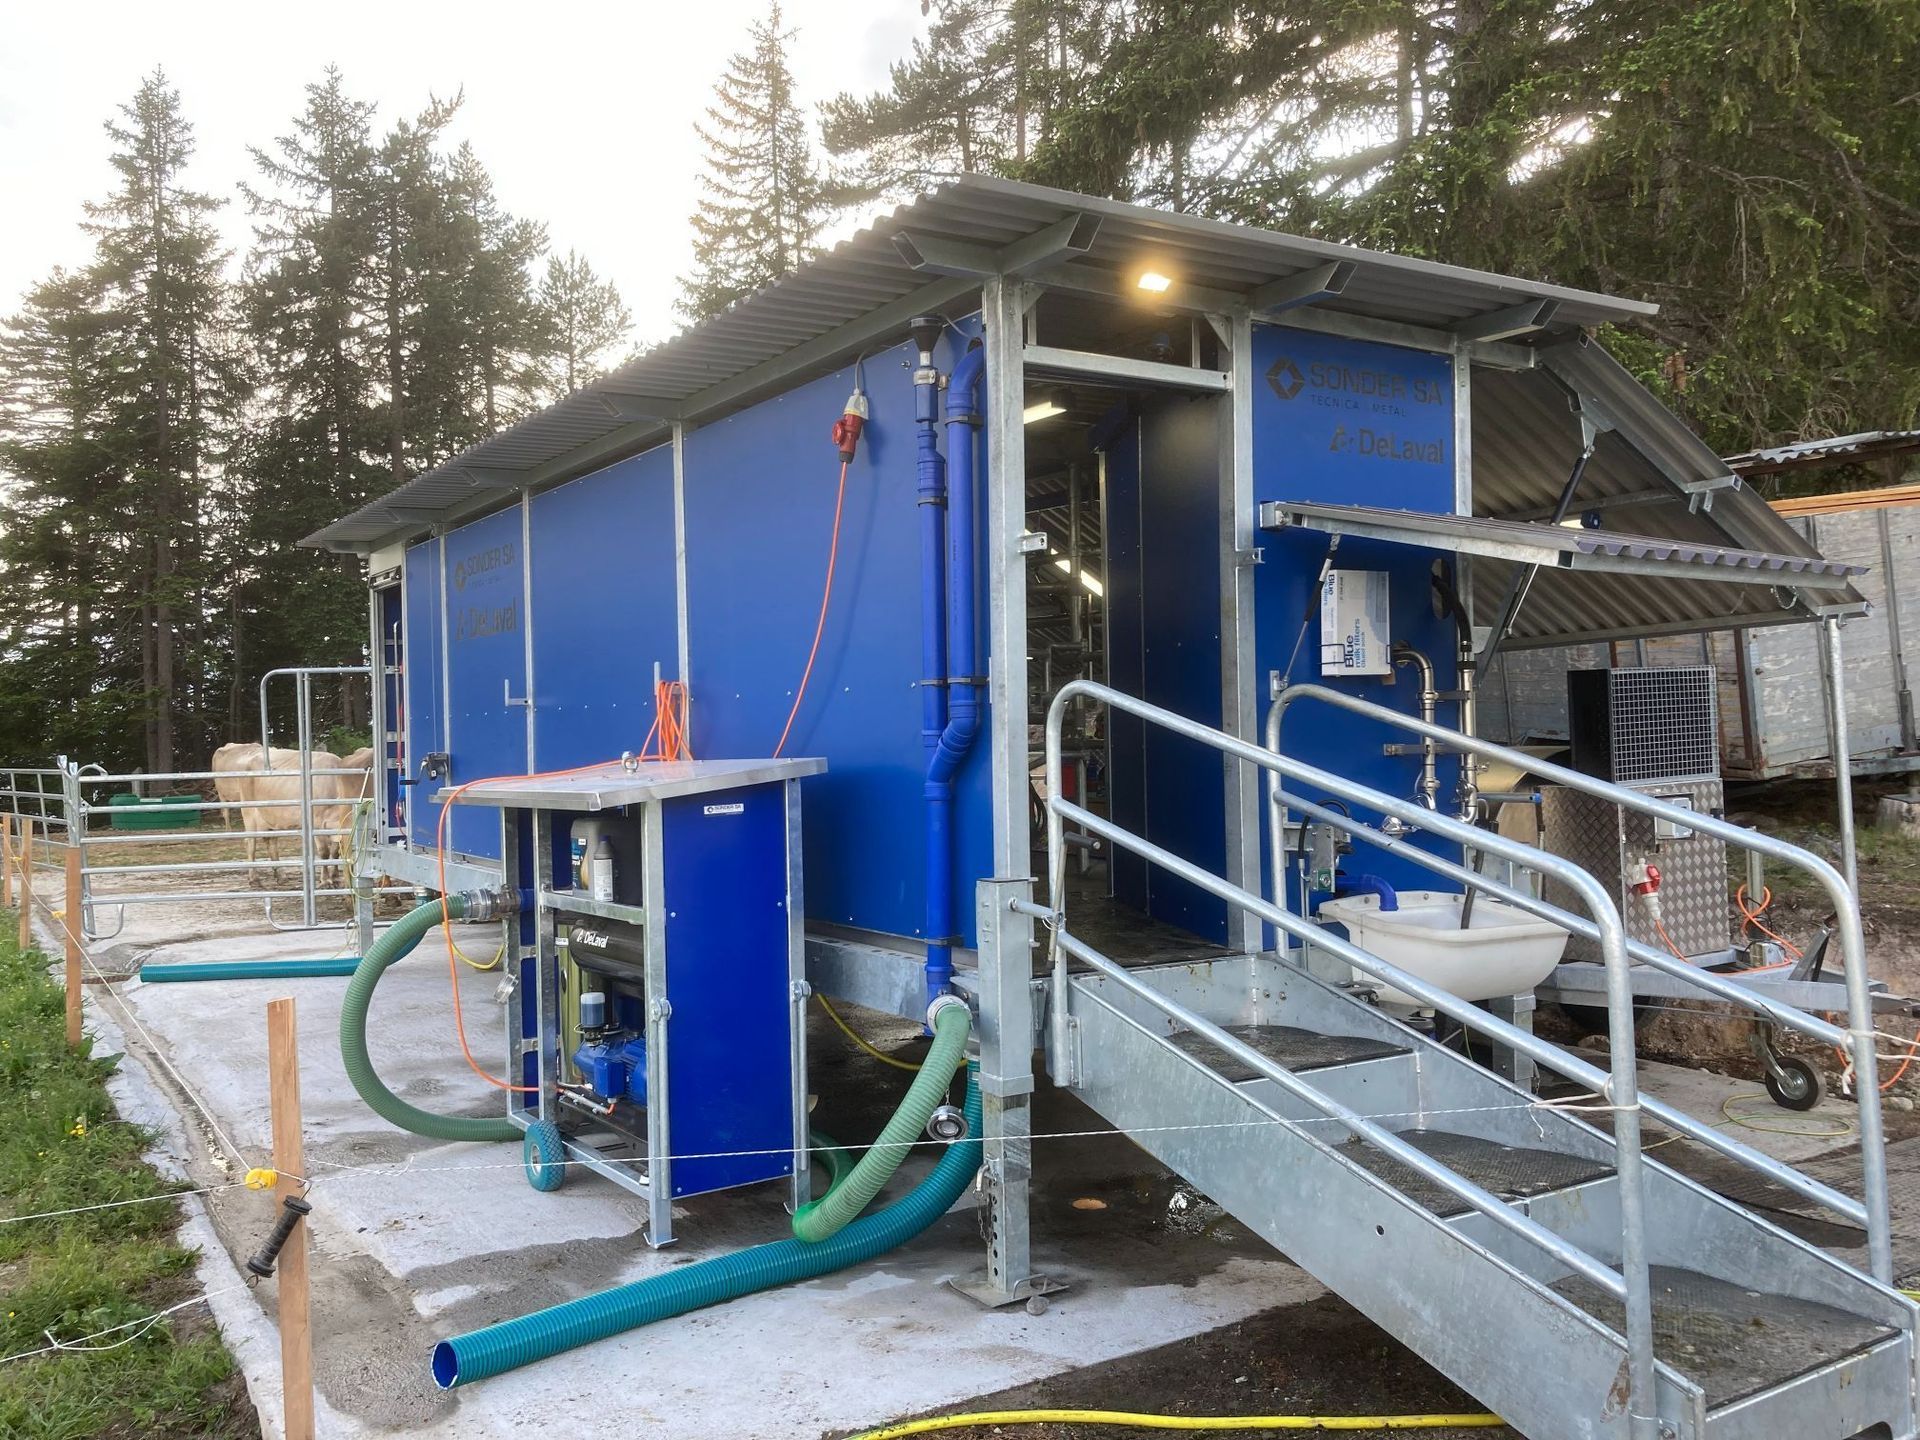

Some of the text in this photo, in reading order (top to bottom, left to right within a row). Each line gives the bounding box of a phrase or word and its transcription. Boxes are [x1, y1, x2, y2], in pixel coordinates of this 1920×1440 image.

[1310, 364, 1442, 405] SONDER SA
[1372, 403, 1407, 417] METAL
[1359, 428, 1444, 464] DeLaval
[467, 543, 515, 577] SONDER SA
[1328, 574, 1336, 595] Blue
[469, 597, 517, 639] DeLaval
[1345, 635, 1354, 668] Blue
[584, 932, 609, 948] DeLaval
